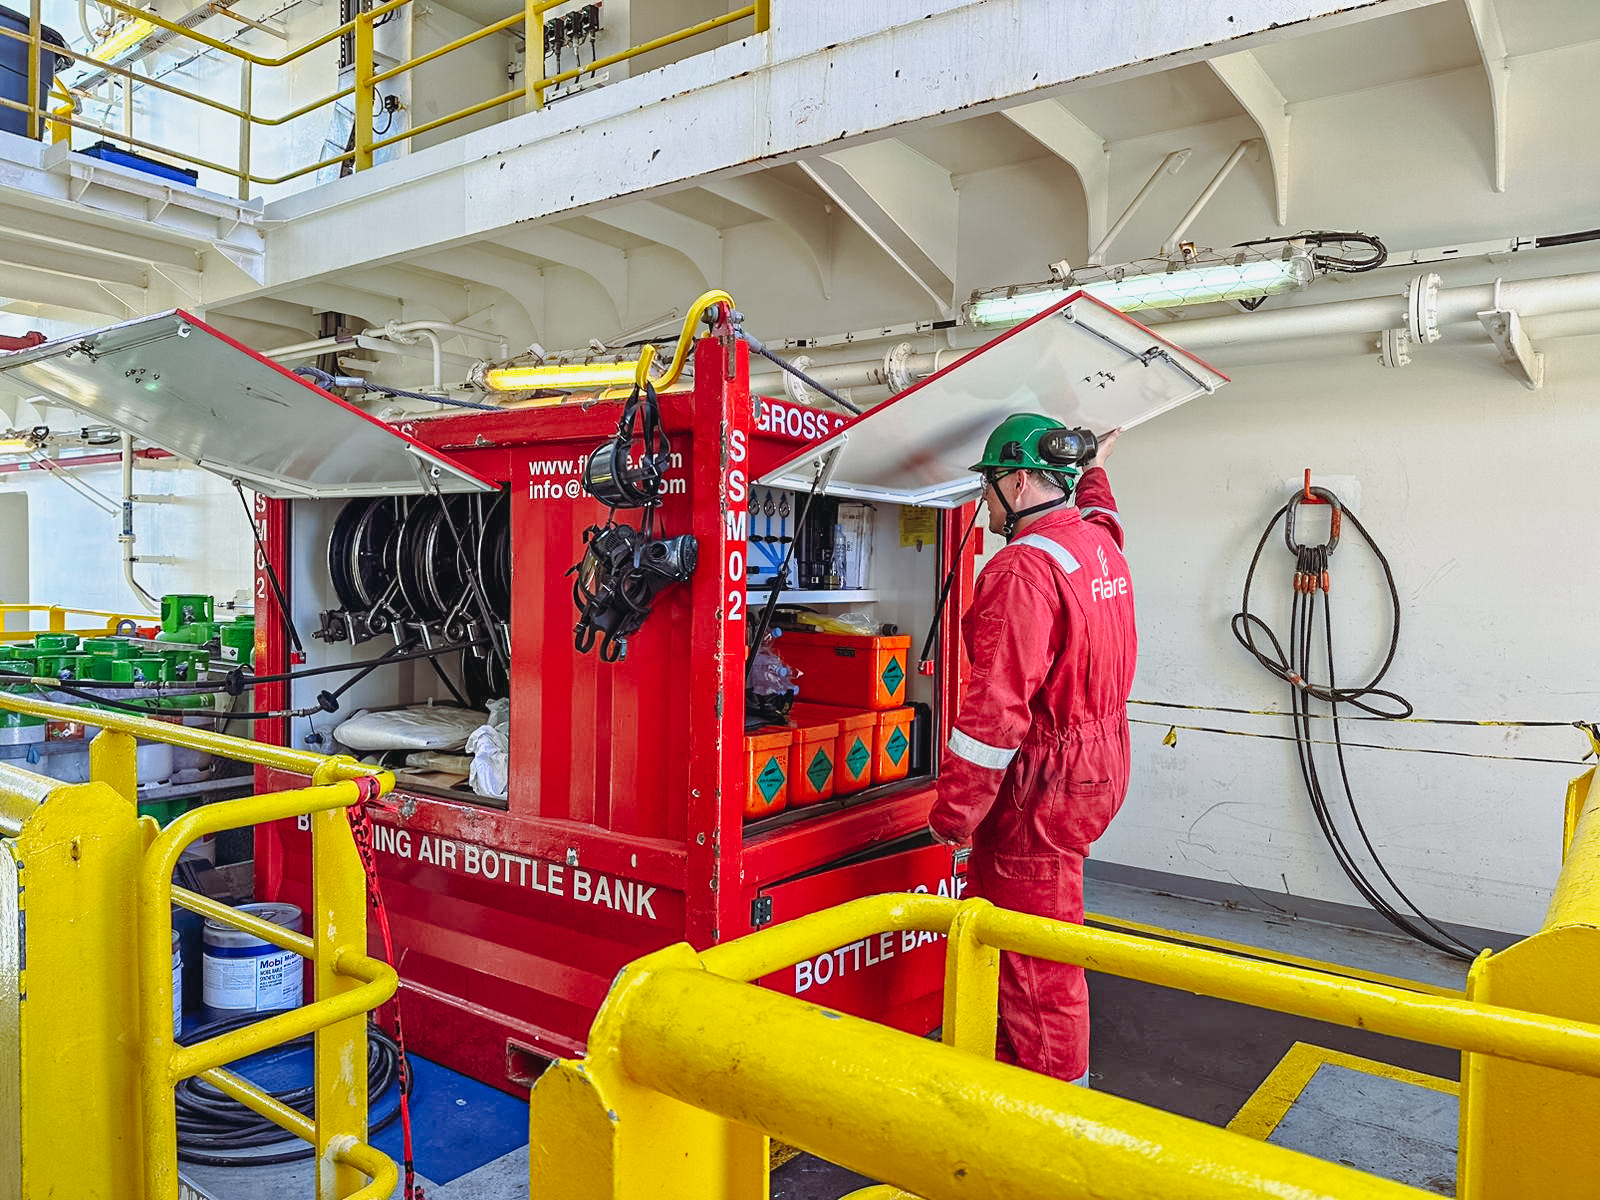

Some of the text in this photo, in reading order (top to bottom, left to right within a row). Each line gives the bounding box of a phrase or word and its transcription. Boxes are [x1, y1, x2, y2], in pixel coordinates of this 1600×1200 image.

[753, 401, 829, 440] GROSS
[418, 835, 457, 870] AIR
[464, 848, 565, 897] BOTTLE
[573, 870, 658, 920] BANK
[795, 930, 895, 994] BOTTLE
